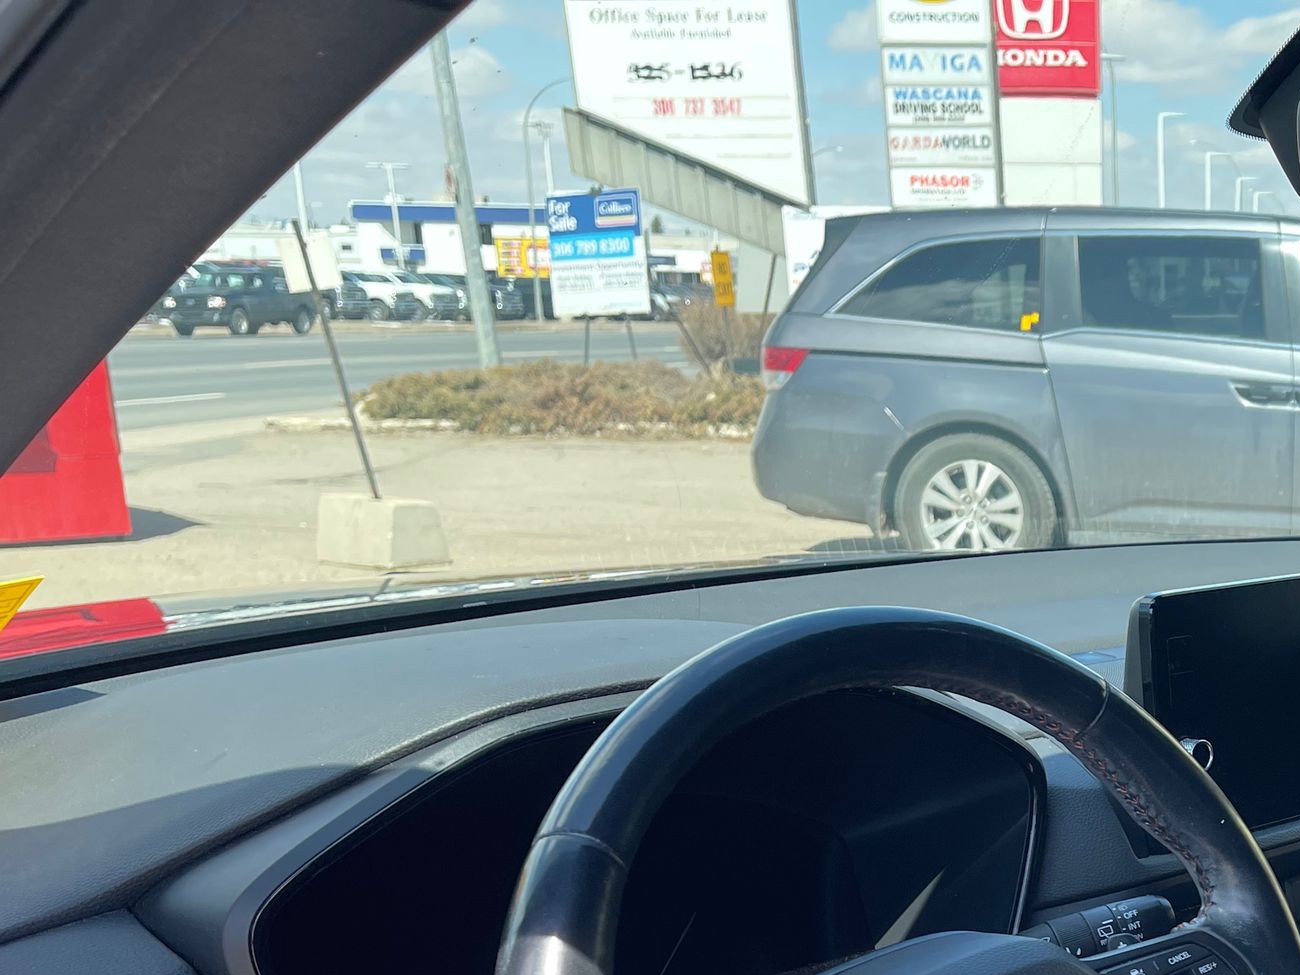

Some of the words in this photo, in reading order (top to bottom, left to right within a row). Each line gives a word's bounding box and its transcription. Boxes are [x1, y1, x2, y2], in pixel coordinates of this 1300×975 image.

[589, 7, 638, 24] Office
[645, 7, 689, 26] Space
[695, 7, 721, 23] For
[727, 6, 768, 23] Lease
[888, 11, 980, 24] CONSTRUCTION
[893, 87, 983, 100] WASCANA
[893, 101, 938, 114] DRIVING
[941, 101, 984, 114] SCHOOL
[889, 134, 991, 150] GARDAWORLD
[548, 199, 571, 215] For
[549, 215, 578, 232] Sale
[1123, 909, 1139, 920] OFF
[1128, 920, 1142, 931] INT
[1167, 951, 1192, 965] CANCEL
